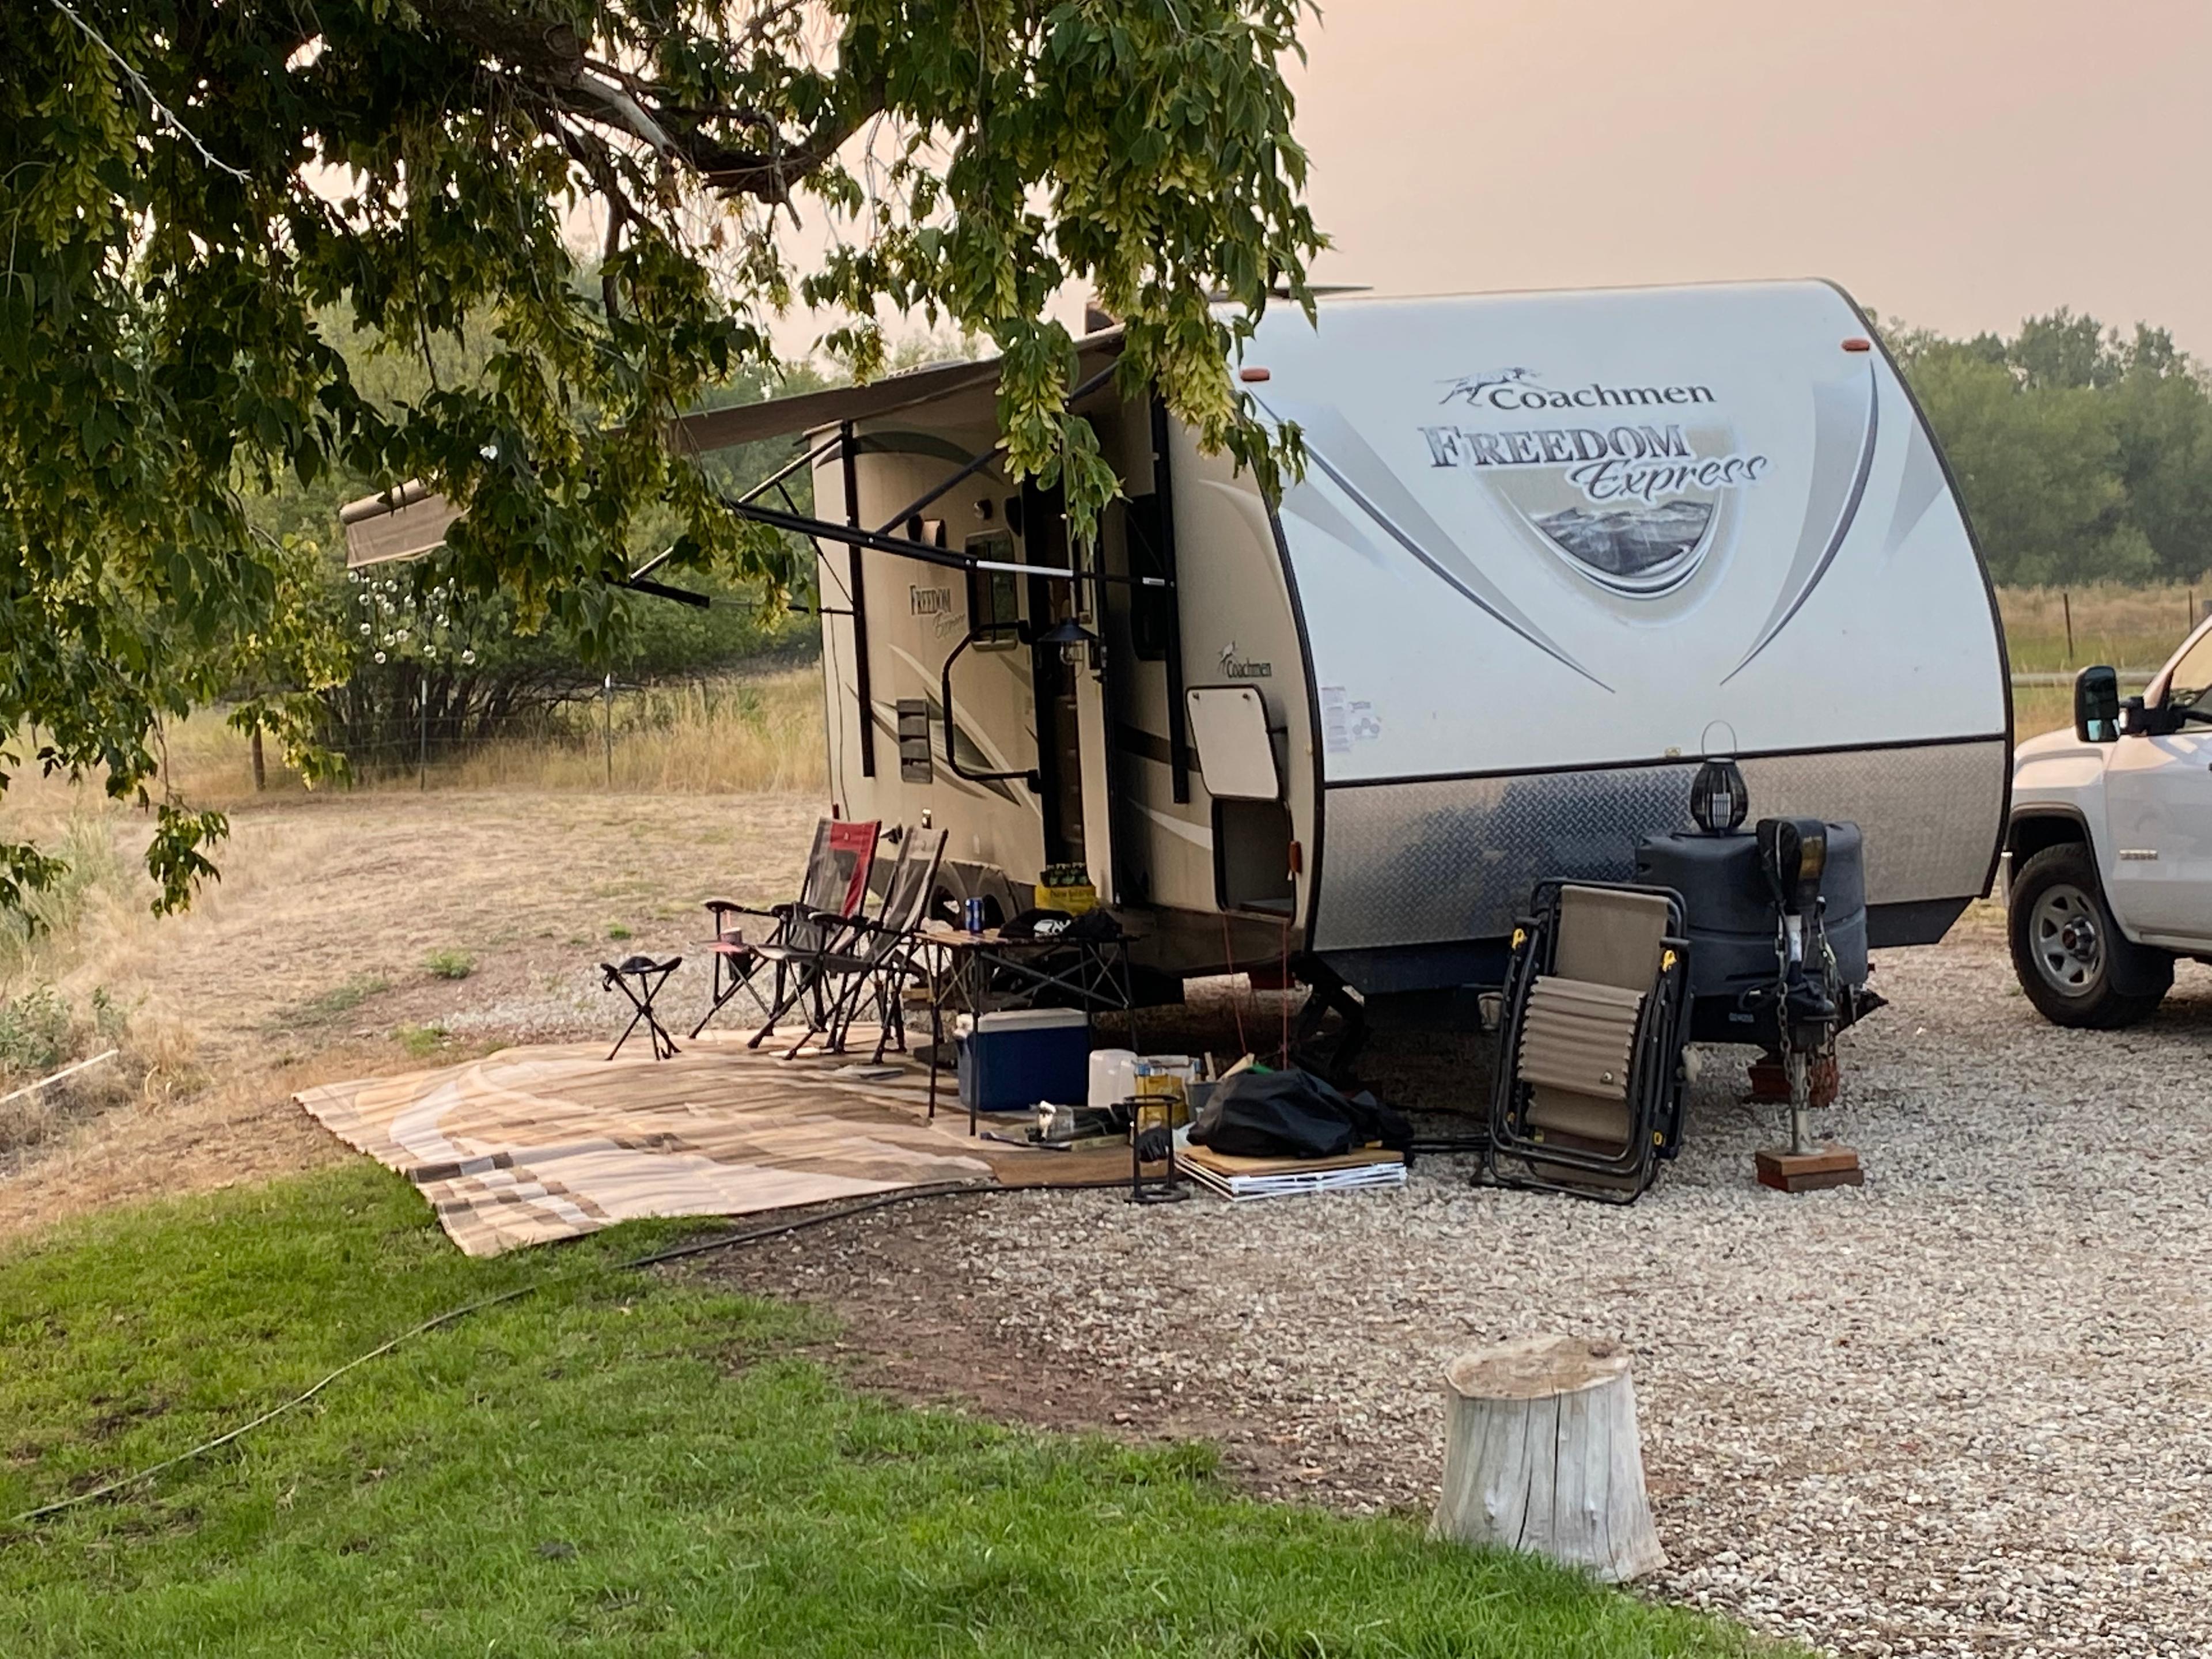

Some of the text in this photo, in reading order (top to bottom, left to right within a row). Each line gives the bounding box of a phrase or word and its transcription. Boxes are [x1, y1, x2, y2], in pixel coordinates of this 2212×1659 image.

[1488, 383, 1717, 410] Coachmen
[1417, 424, 1691, 468] FREEDOM
[1570, 455, 1767, 502] Express
[910, 585, 952, 616] FREEDOM
[1226, 657, 1272, 678] Coachmen
